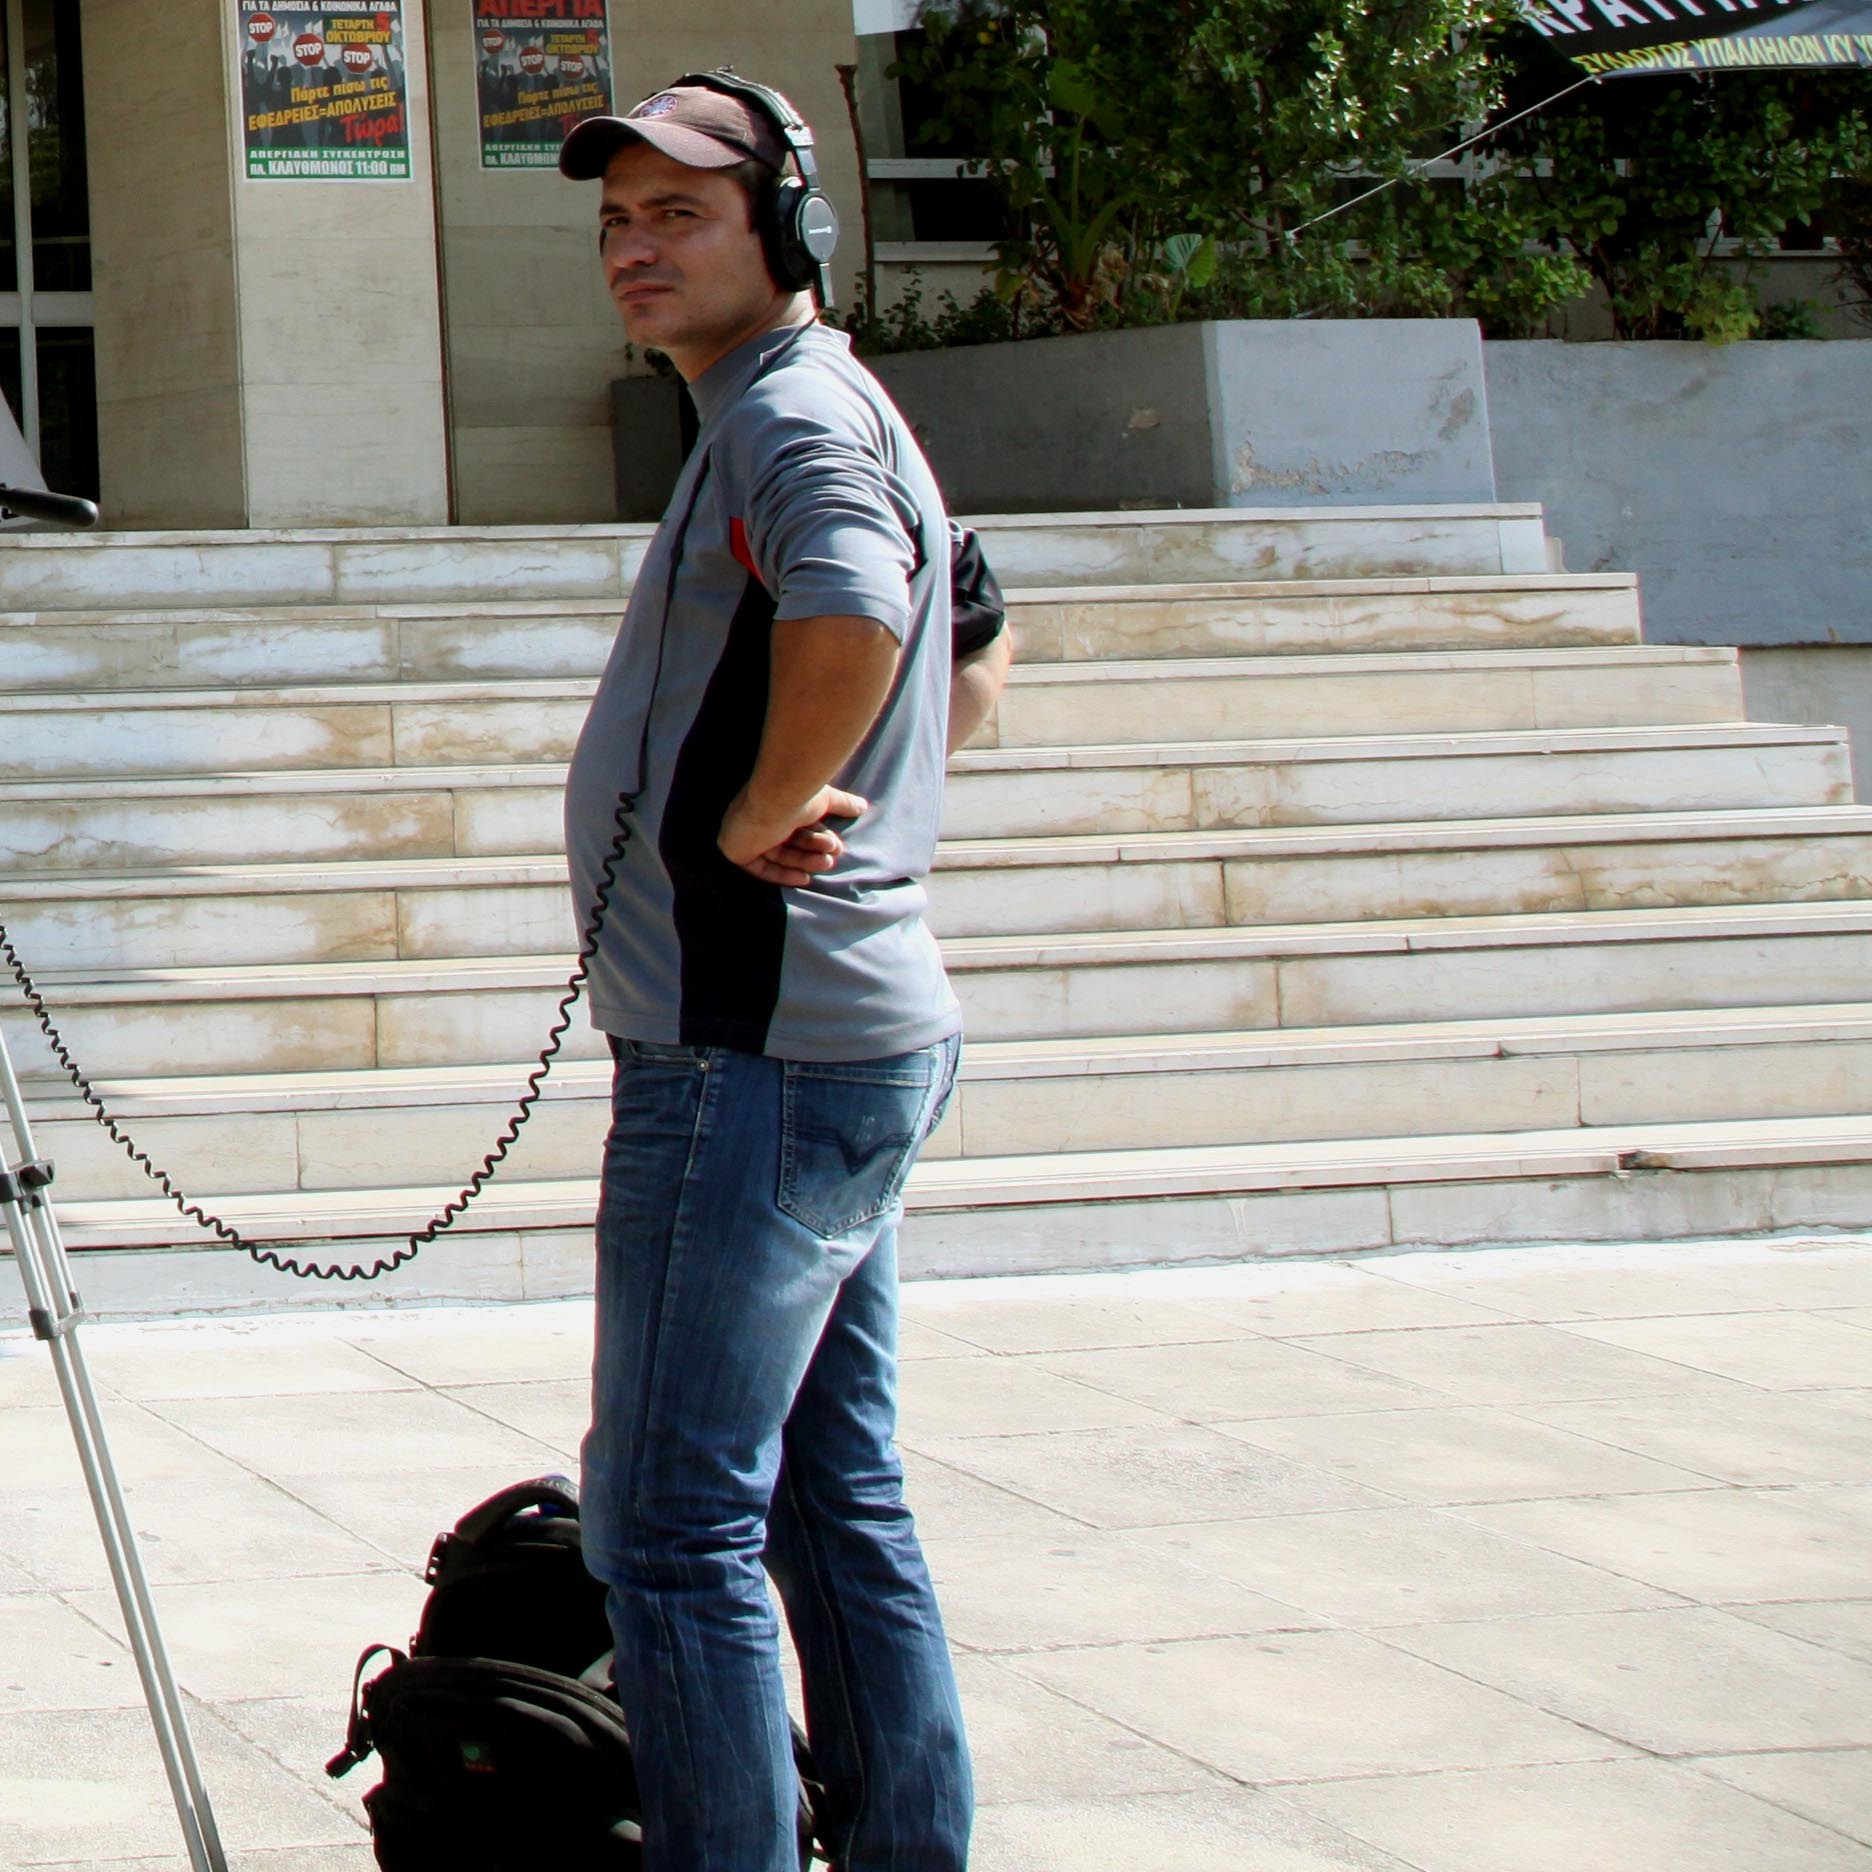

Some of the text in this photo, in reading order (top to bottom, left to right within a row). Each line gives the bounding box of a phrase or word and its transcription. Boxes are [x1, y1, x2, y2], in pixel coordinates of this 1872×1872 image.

[242, 0, 257, 11] ΓΙΑ
[258, 0, 270, 11] ΤΑ
[248, 22, 273, 34] STOP
[482, 37, 503, 47] STOP
[295, 43, 322, 57] STOP
[1569, 40, 1696, 74] ΣΥΛΛΟΓΟΣ
[1690, 34, 1827, 67] ΥΠΑΛΛΗΛΩΝ
[1823, 33, 1857, 64] ΚΥ
[343, 51, 371, 64] STOP
[520, 54, 544, 66] STOP
[560, 61, 583, 73] STOP
[355, 161, 388, 175] 11:00
